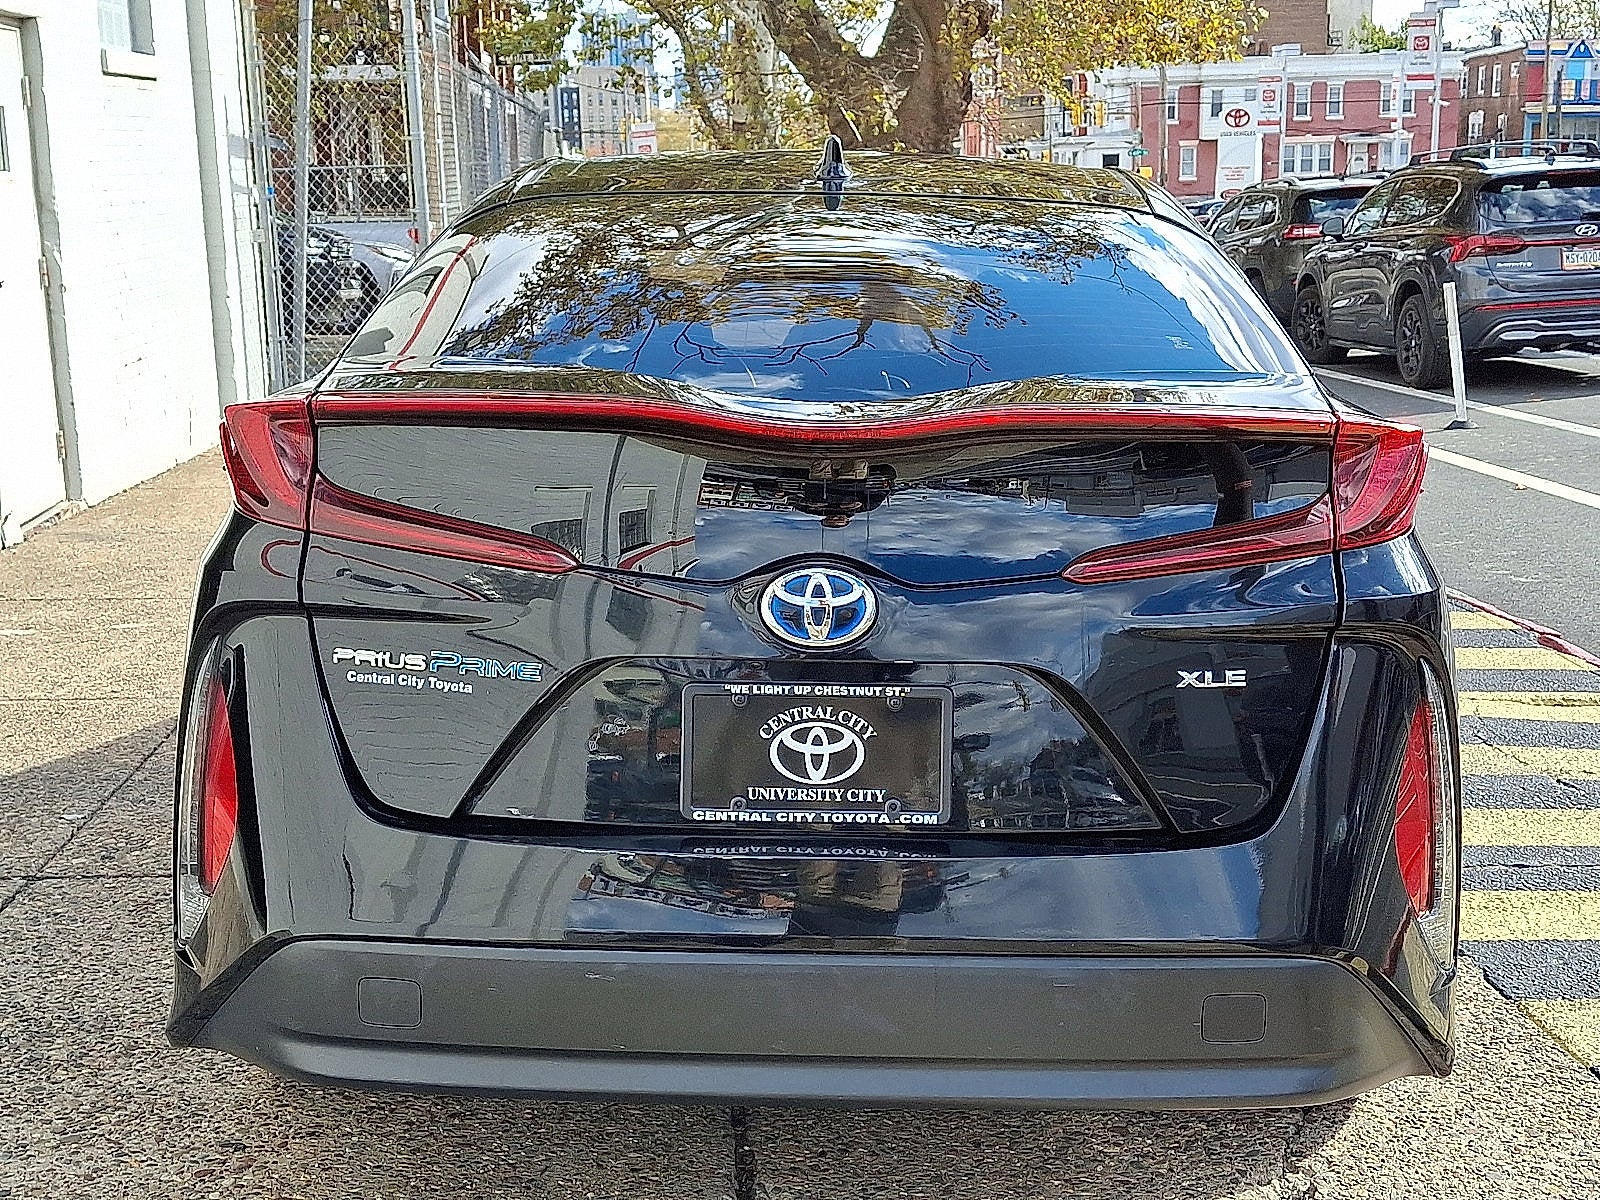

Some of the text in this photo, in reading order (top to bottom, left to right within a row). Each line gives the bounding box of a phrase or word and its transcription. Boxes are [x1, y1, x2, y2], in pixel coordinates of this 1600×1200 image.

[332, 647, 543, 682] PRIUS PRIME
[346, 670, 474, 694] Central City Toyota
[1176, 669, 1247, 688] XLE
[752, 685, 791, 695] LIGHT
[793, 685, 812, 695] UP
[814, 685, 883, 697] CHESTNUT
[759, 705, 878, 742] CENTRAL CITY
[747, 787, 887, 803] UNIVERSITY CITY
[692, 810, 939, 825] CENTRAL CITY TOYOTA .COM
